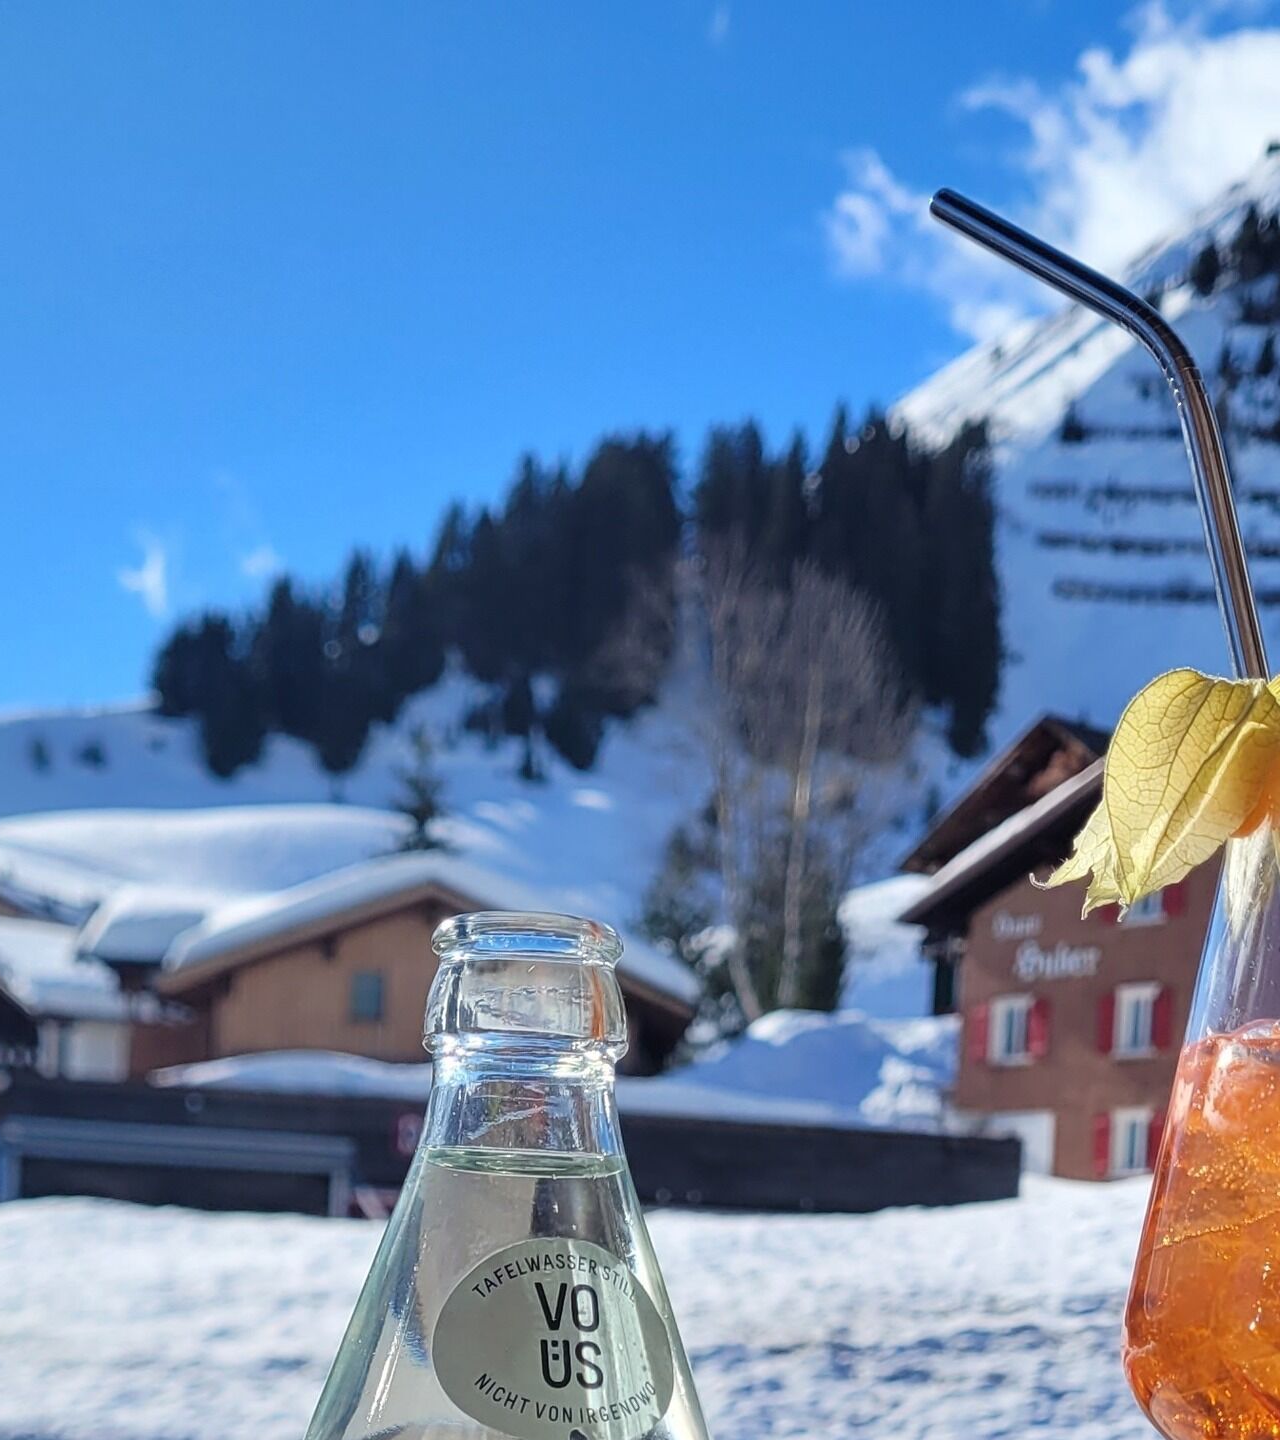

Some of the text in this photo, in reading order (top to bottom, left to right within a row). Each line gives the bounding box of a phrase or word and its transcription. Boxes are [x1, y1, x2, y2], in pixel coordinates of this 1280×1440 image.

[472, 1254, 636, 1301] TAFELWASSER STILL
[534, 1282, 600, 1332] VO
[540, 1339, 604, 1389] ÜS
[474, 1373, 656, 1425] NICHT VON IRGENDWO
